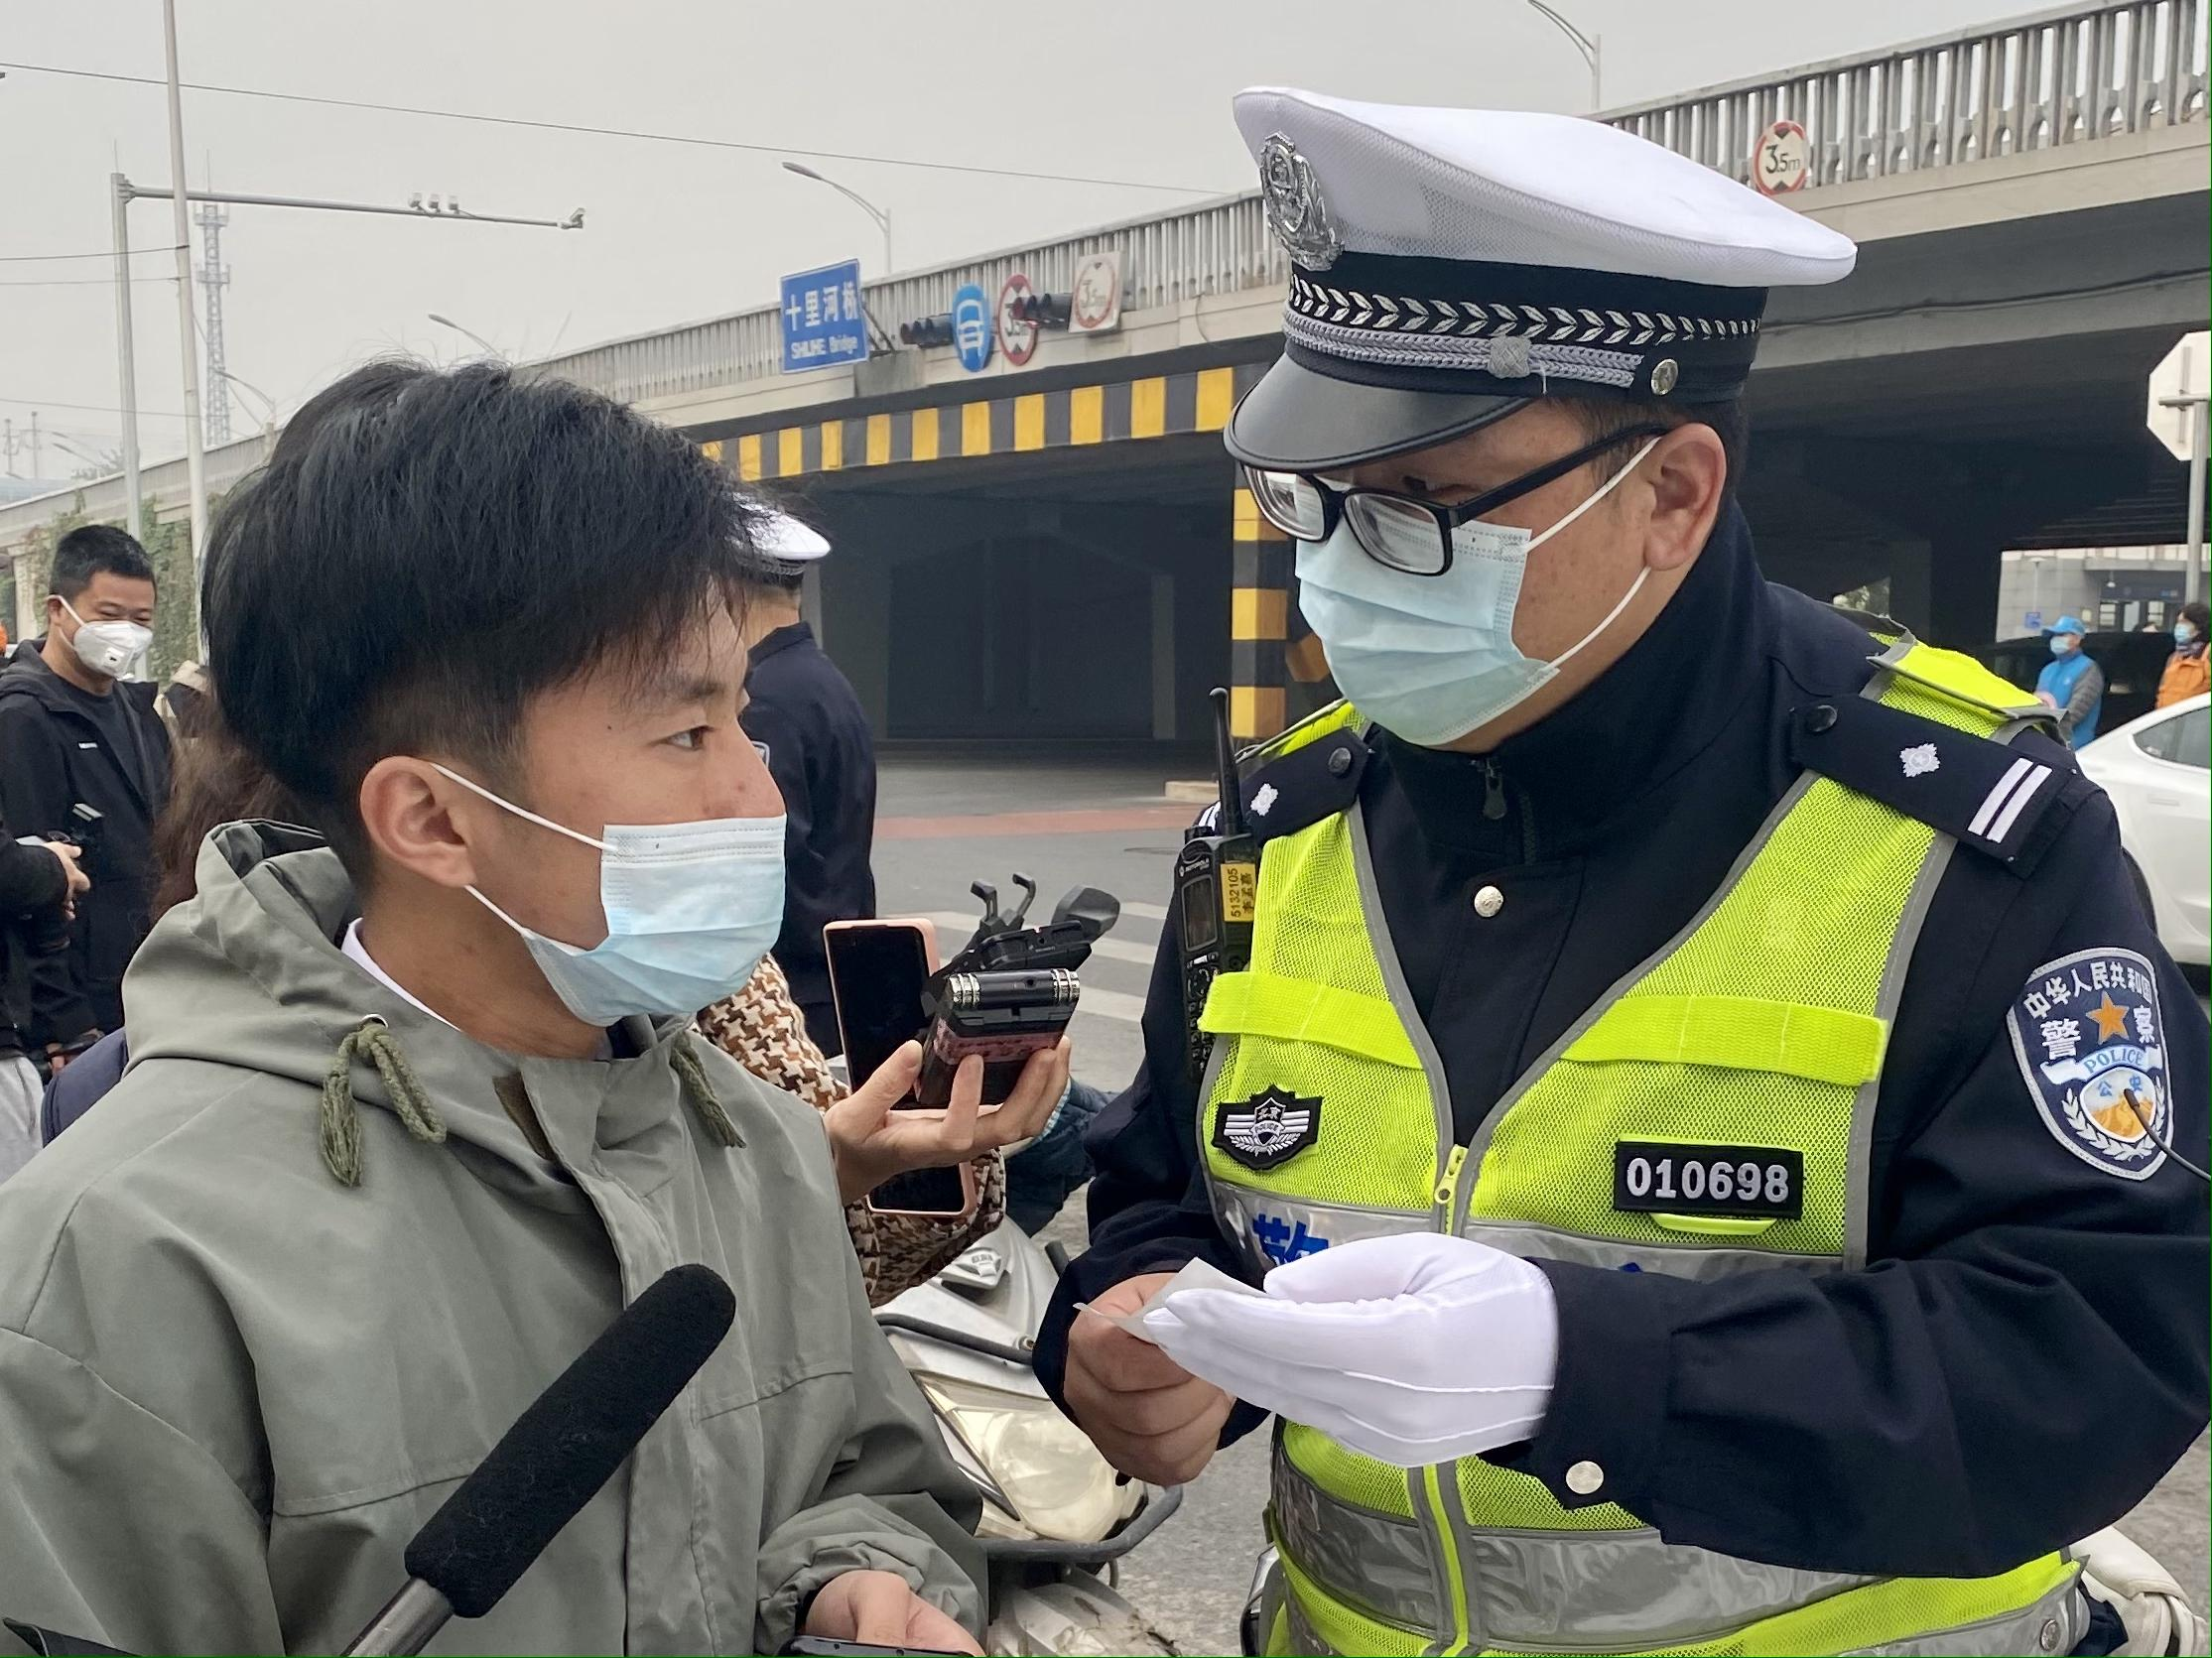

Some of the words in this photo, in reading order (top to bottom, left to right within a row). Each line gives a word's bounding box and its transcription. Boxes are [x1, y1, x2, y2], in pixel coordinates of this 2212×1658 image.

[785, 281, 858, 331] 十里河桥
[1228, 868, 1241, 917] 5132105
[2023, 960, 2152, 1019] 中华人民共和国
[2084, 1048, 2145, 1074] POLICE
[1626, 1158, 1788, 1203] 010698
